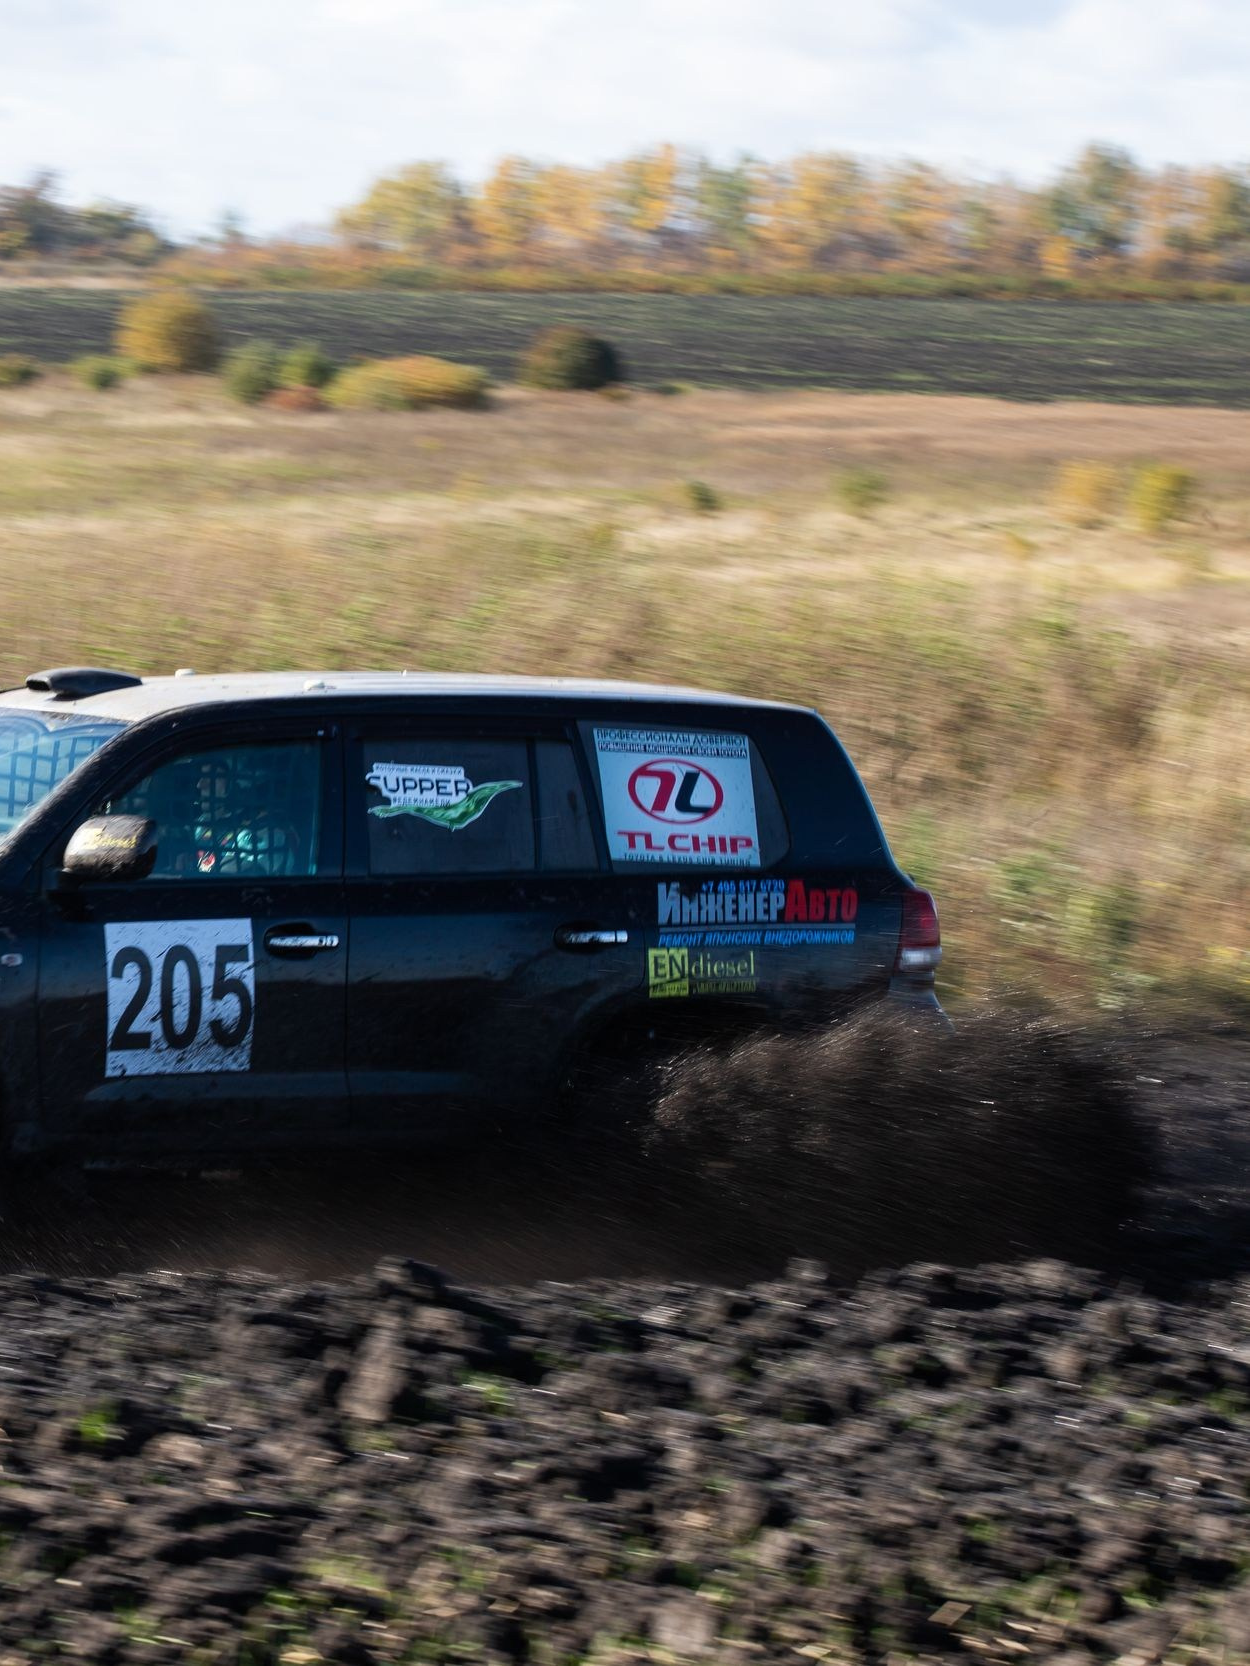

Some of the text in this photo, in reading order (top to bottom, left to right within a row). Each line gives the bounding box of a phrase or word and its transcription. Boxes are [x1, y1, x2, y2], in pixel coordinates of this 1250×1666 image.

[597, 730, 746, 745] ПРОФЕССИОНАЛЫ ДОВЕРЯЮТ
[658, 929, 855, 947] РЕМОНТ ЯПОНСКИХ ВНЕДОРОЖНИКОВ
[109, 944, 253, 1051] 205
